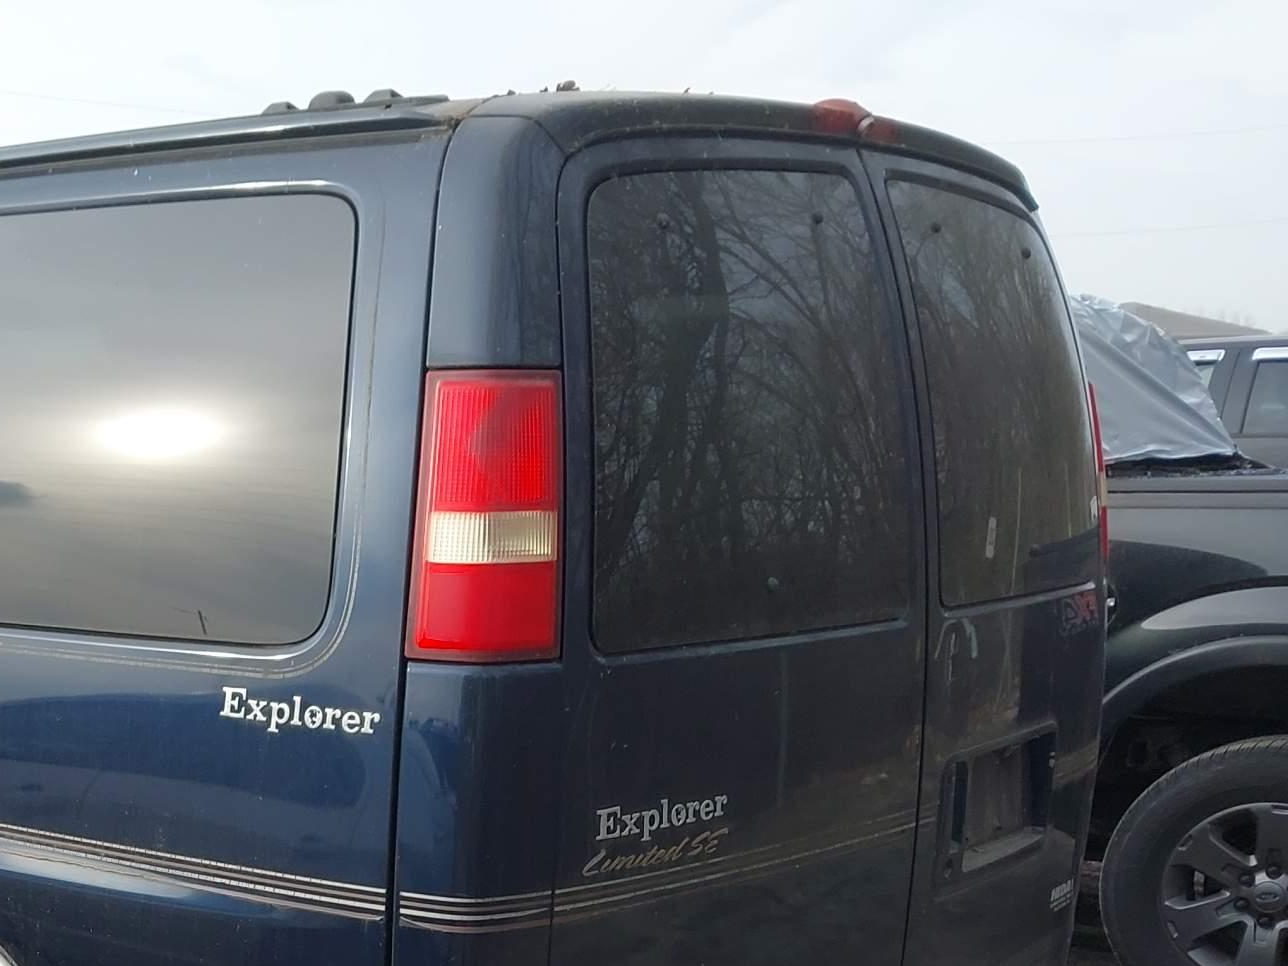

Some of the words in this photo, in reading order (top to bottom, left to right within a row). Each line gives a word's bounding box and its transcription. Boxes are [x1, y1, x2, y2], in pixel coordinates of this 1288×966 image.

[219, 686, 381, 734] Explorer
[595, 794, 728, 841] Explorer
[582, 837, 689, 877] Limited
[687, 827, 729, 856] SE
